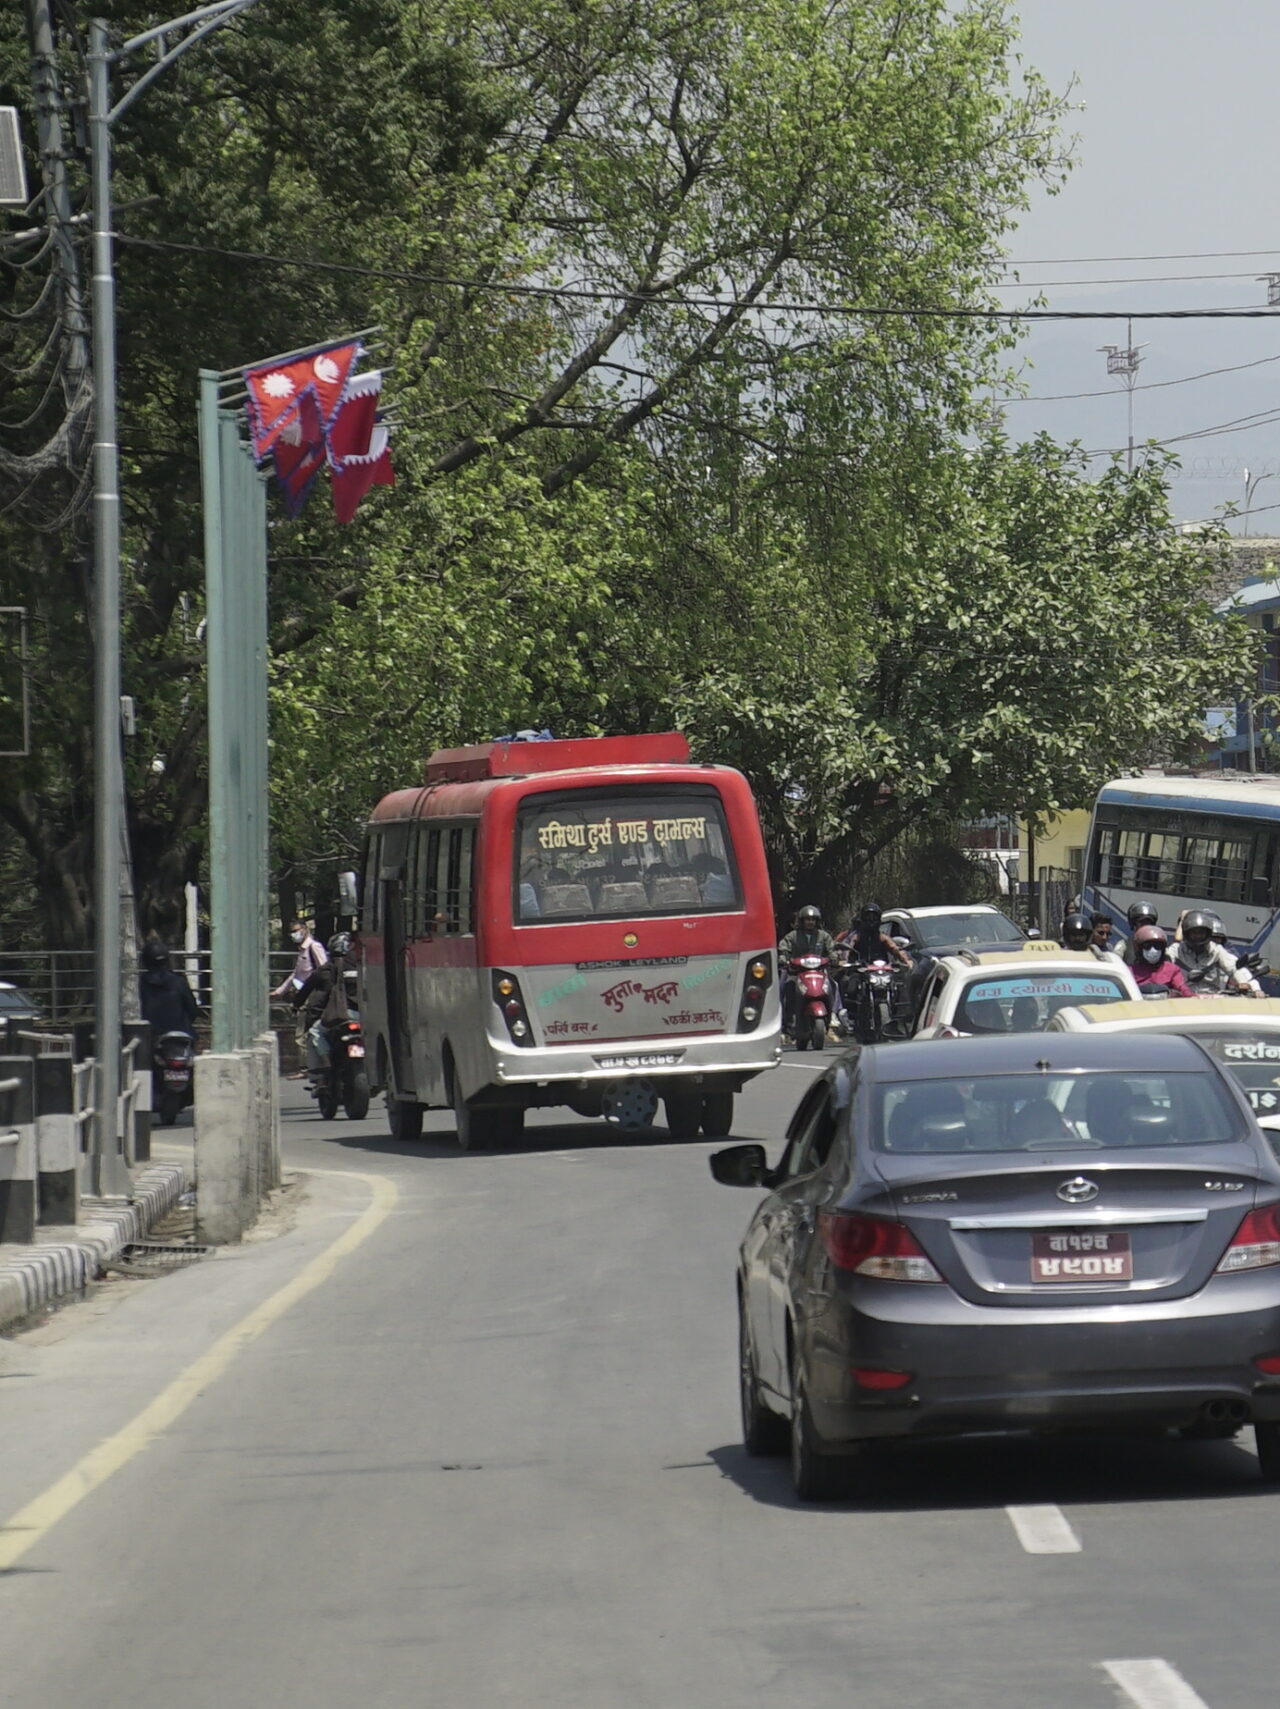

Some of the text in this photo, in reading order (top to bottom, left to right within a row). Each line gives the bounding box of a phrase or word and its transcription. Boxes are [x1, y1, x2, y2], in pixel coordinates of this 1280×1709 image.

[588, 817, 613, 853] टुर्स
[616, 820, 649, 844] एण्ड
[1029, 944, 1055, 952] TAXI
[578, 956, 688, 971] ASHOK LEYLAND
